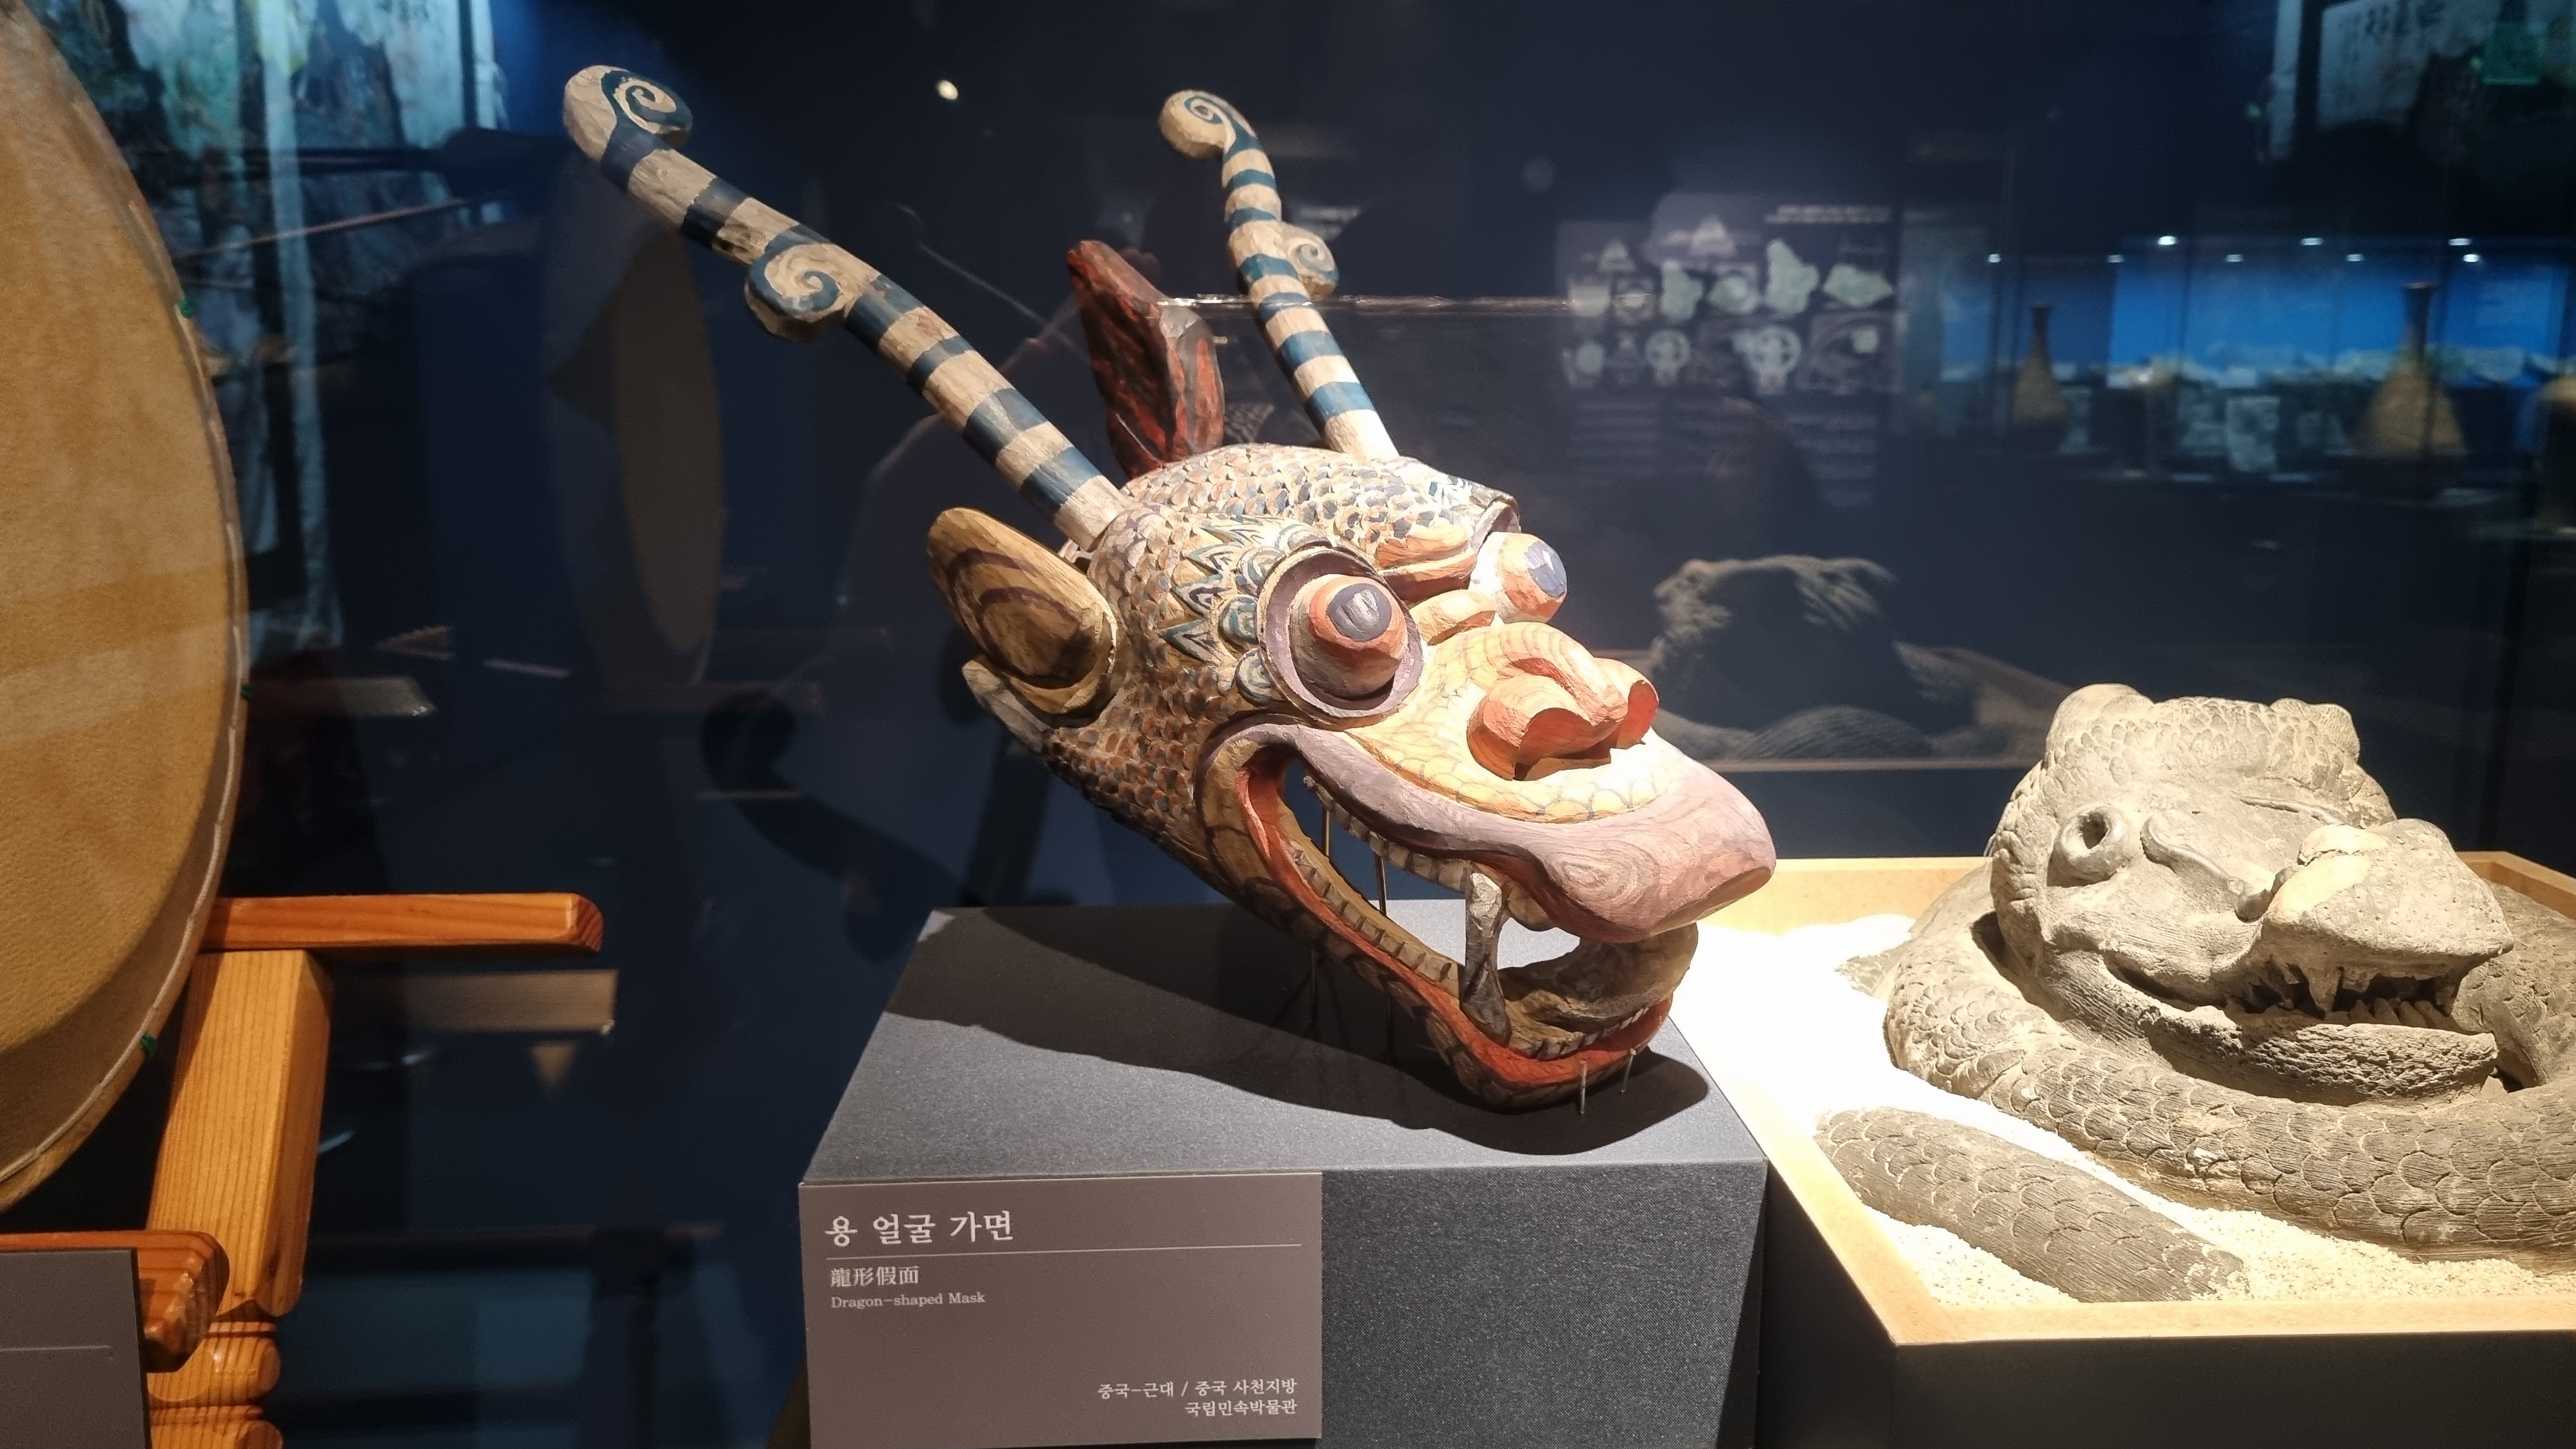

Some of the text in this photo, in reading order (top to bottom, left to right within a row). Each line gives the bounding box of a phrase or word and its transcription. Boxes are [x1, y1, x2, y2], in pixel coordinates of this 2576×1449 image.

[824, 1209, 1013, 1247] 용 얼굴 가면
[831, 1265, 919, 1287] 龍形假面
[831, 1291, 986, 1309] Dragon-shaped Mask
[1098, 1377, 1298, 1400] 중국-근대 / 중국 사천지방
[1184, 1399, 1298, 1417] 국립민속박물관
